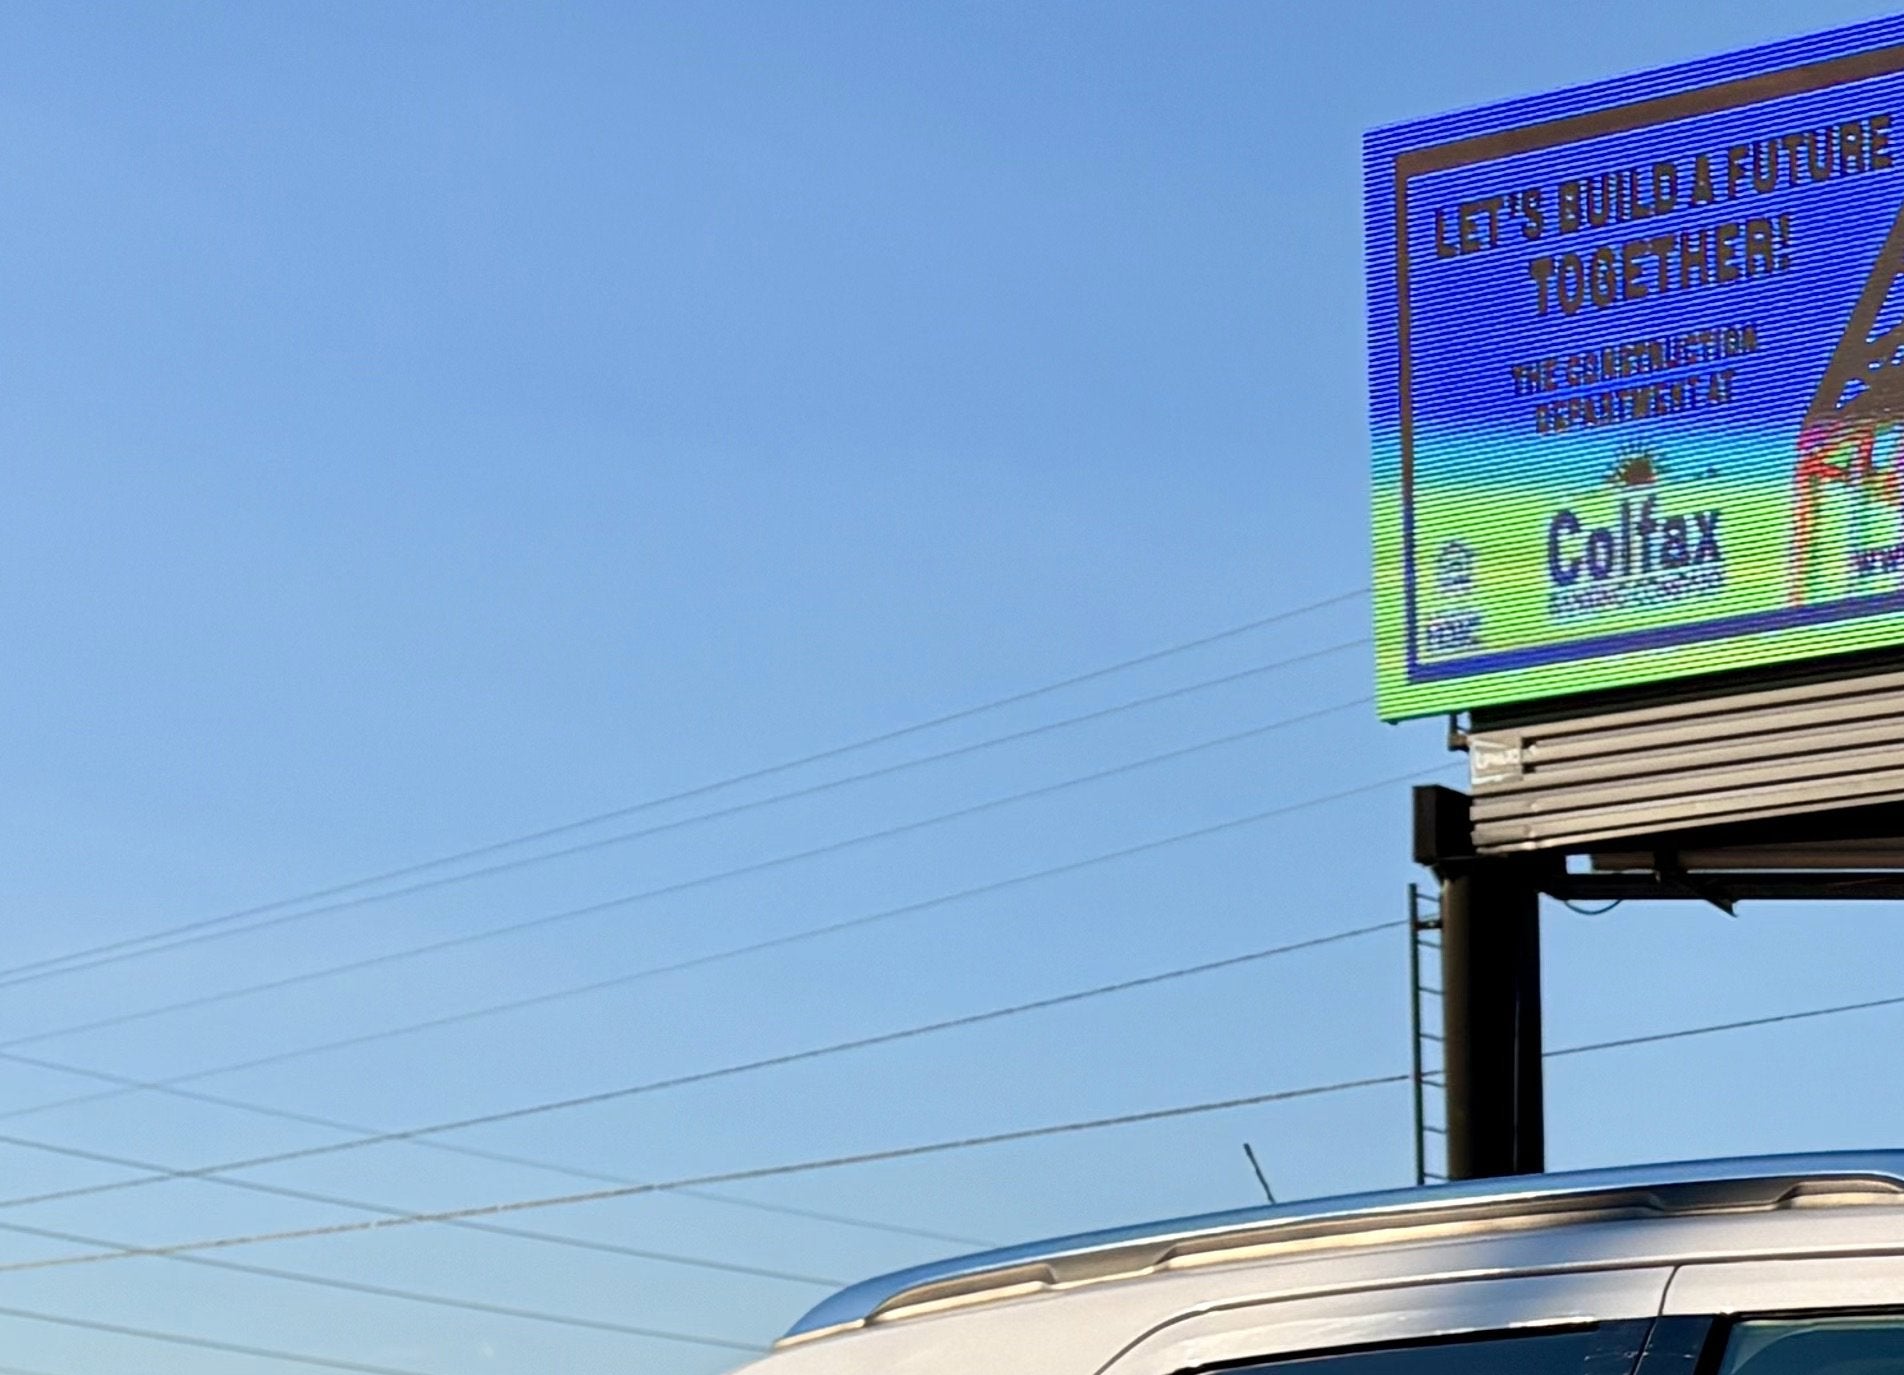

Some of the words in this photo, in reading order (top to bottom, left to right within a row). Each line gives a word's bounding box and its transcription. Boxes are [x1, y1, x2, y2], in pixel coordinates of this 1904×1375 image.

[1434, 188, 1544, 260] LET'S
[1557, 160, 1679, 235] BUILD
[1690, 152, 1716, 206] A
[1725, 113, 1895, 202] FUTURE
[1528, 213, 1793, 317] TOGETHER!
[1511, 358, 1559, 396] THE
[1547, 492, 1722, 588] Colfax
